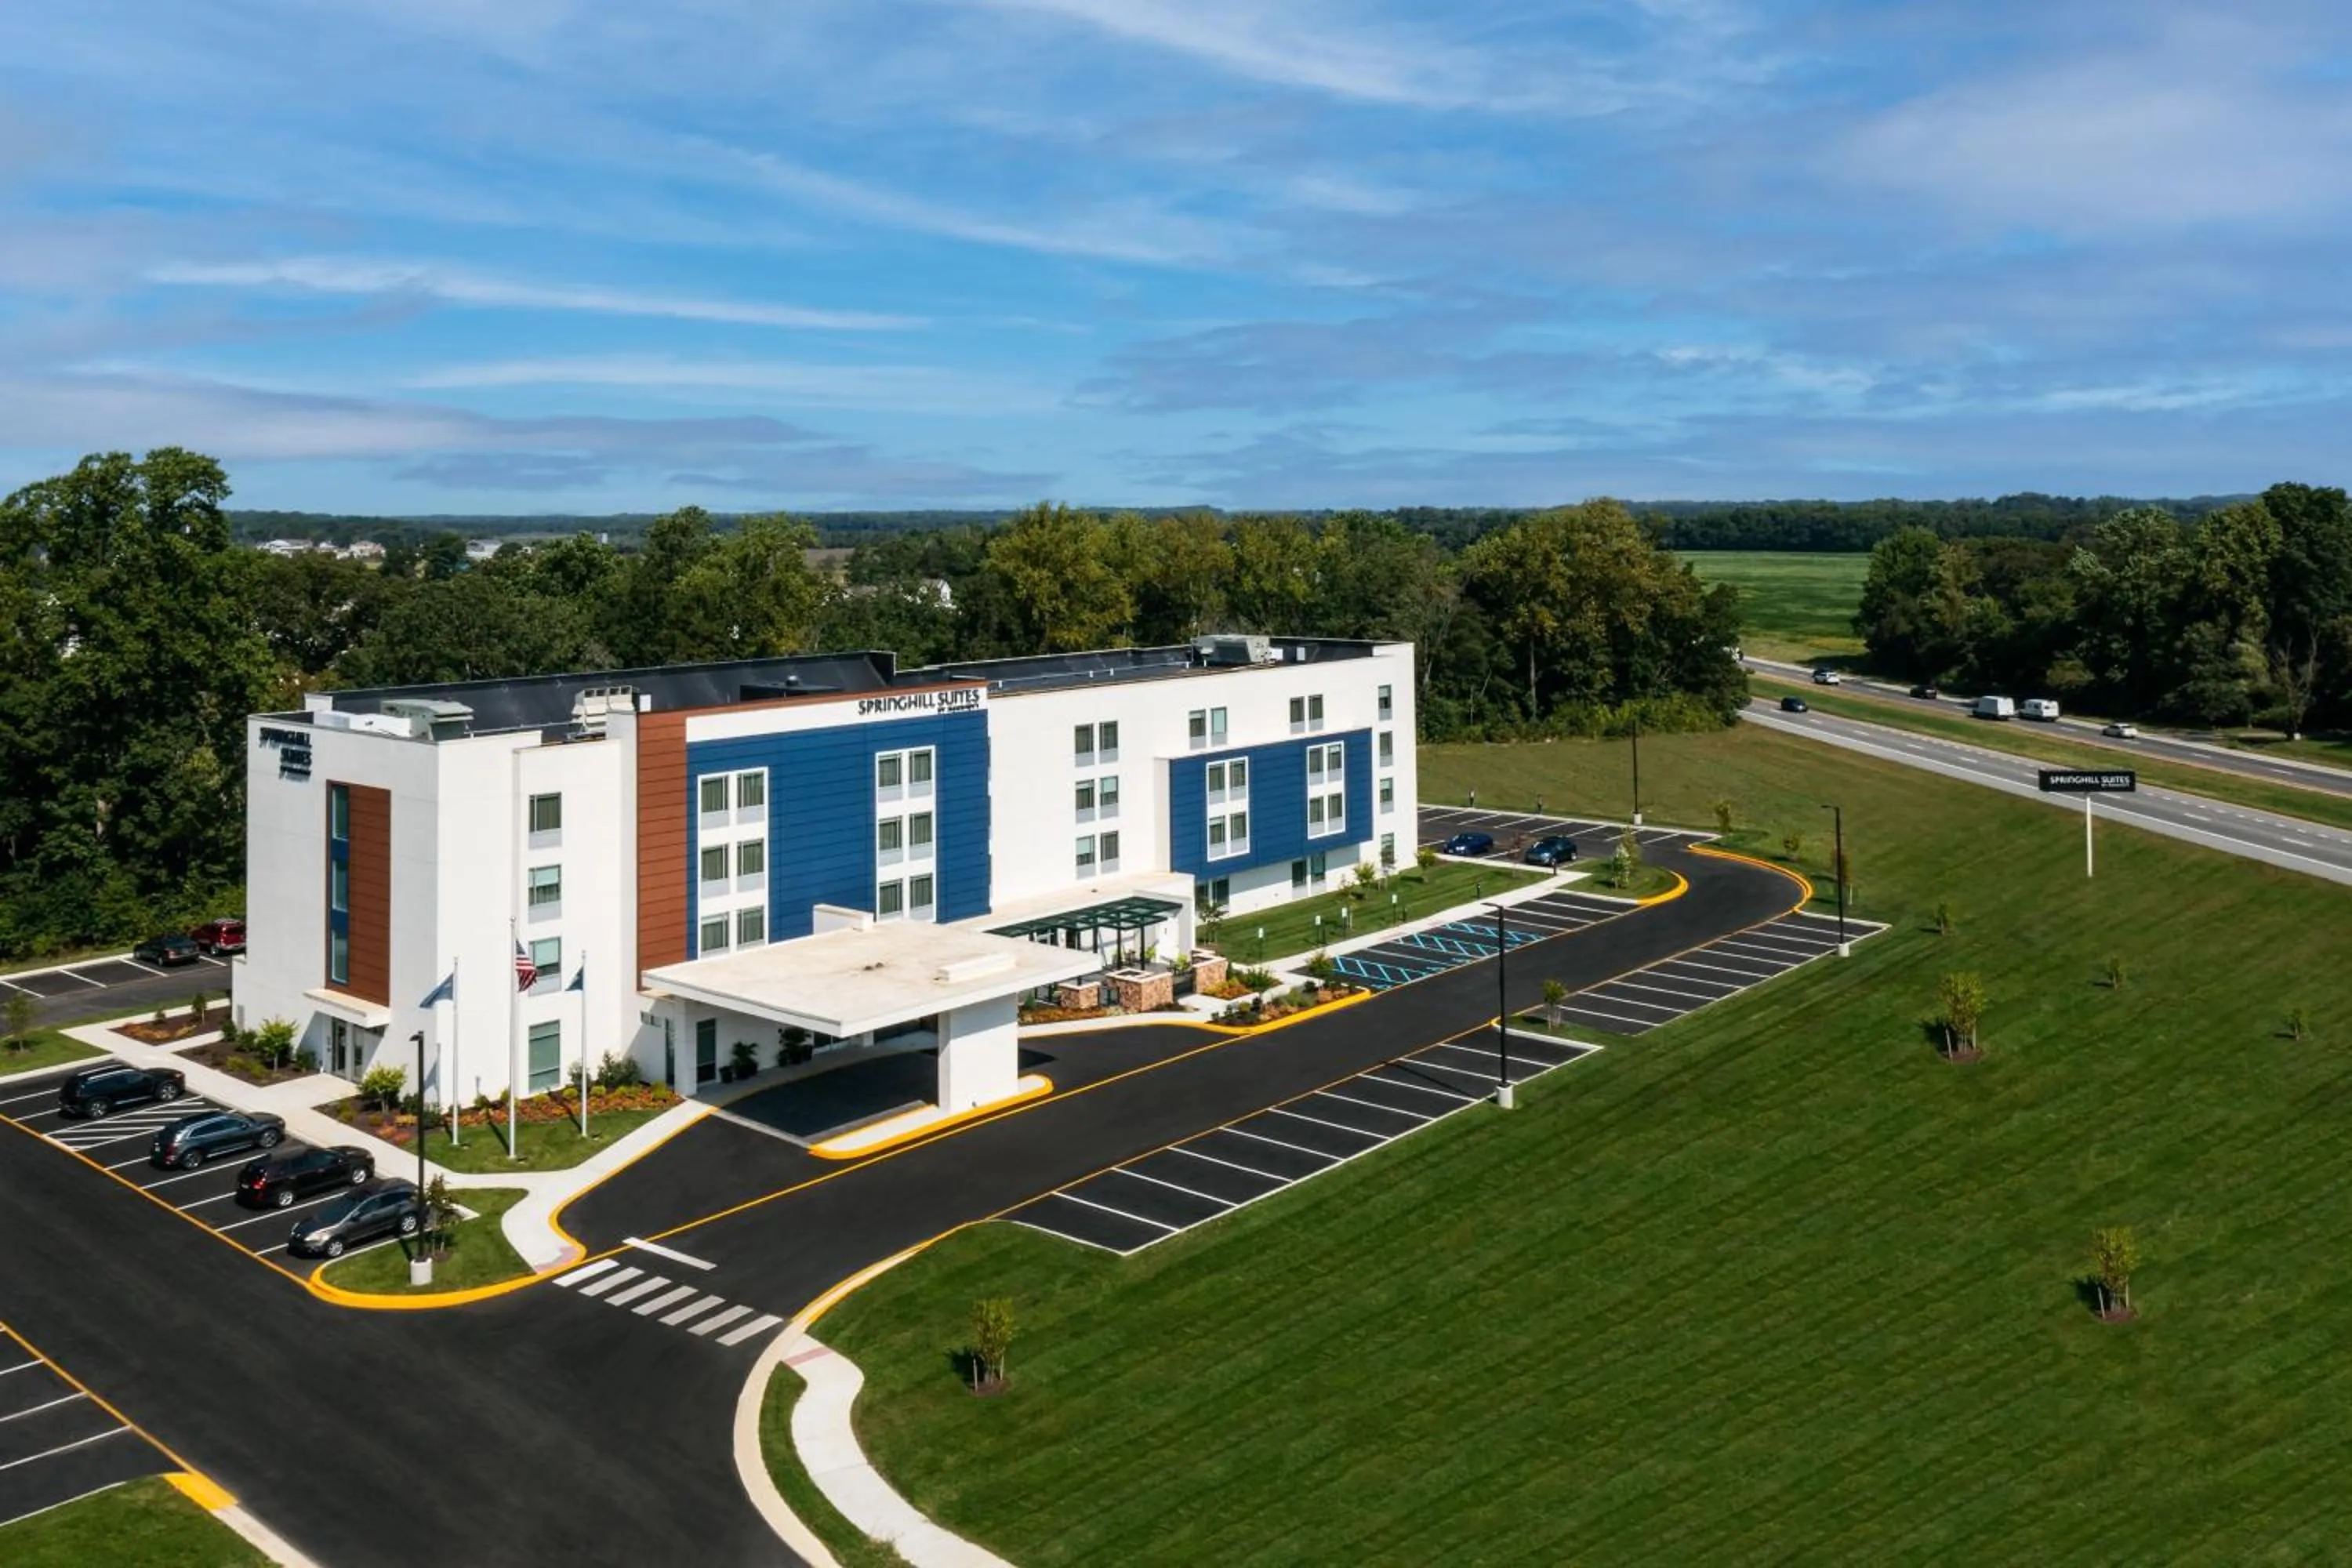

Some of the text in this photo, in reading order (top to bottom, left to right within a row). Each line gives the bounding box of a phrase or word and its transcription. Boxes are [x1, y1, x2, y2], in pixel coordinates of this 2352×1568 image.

[858, 693, 935, 715] SPRINGHILL
[937, 689, 980, 706] SUITES
[2049, 775, 2100, 784] SPRINGHILL
